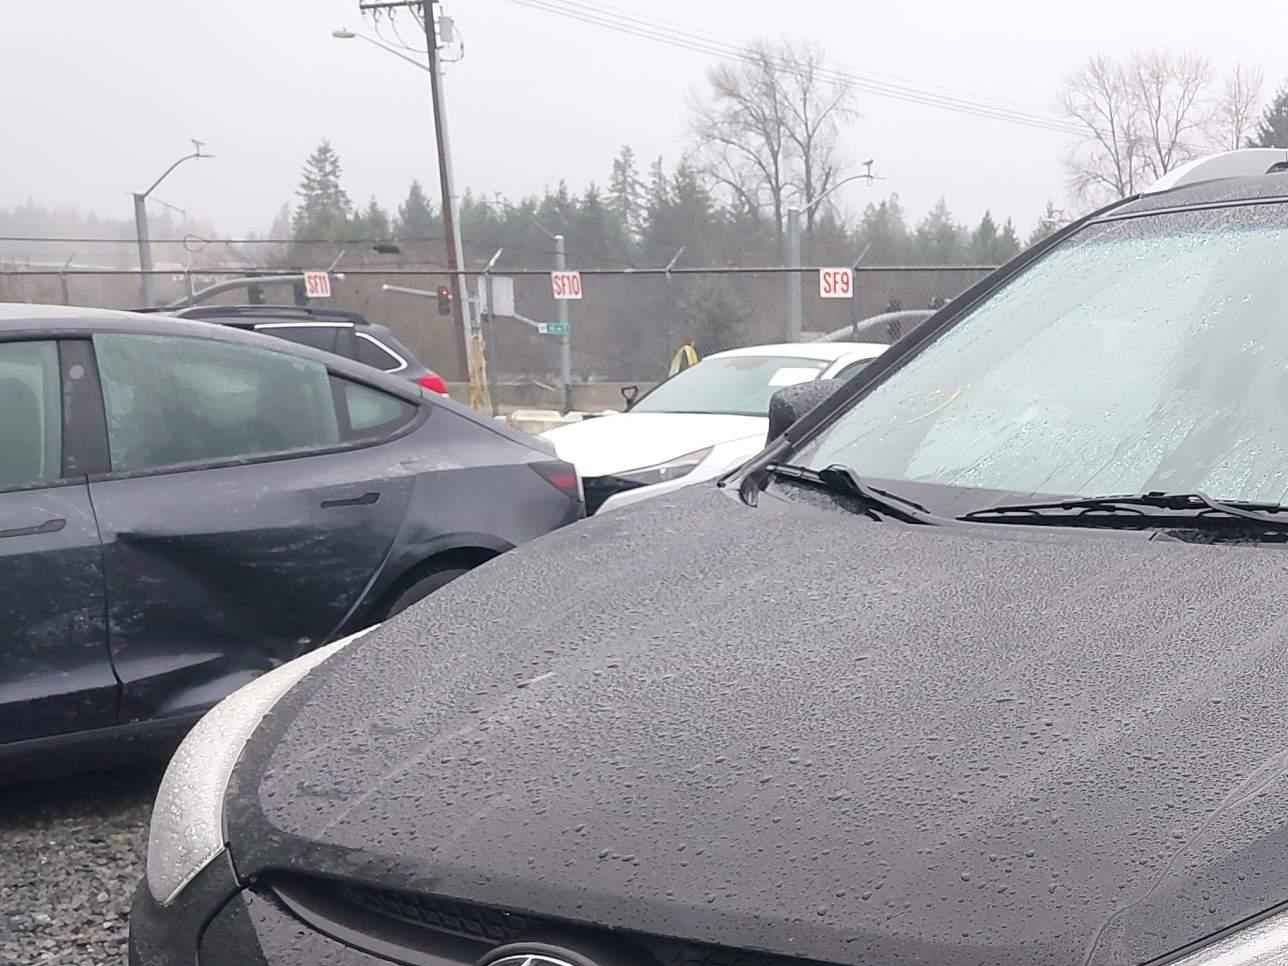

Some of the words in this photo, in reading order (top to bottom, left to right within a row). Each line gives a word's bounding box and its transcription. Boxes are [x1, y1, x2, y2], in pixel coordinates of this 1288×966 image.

[307, 274, 329, 294] SF11
[554, 274, 581, 296] SF10
[823, 271, 850, 294] SF9
